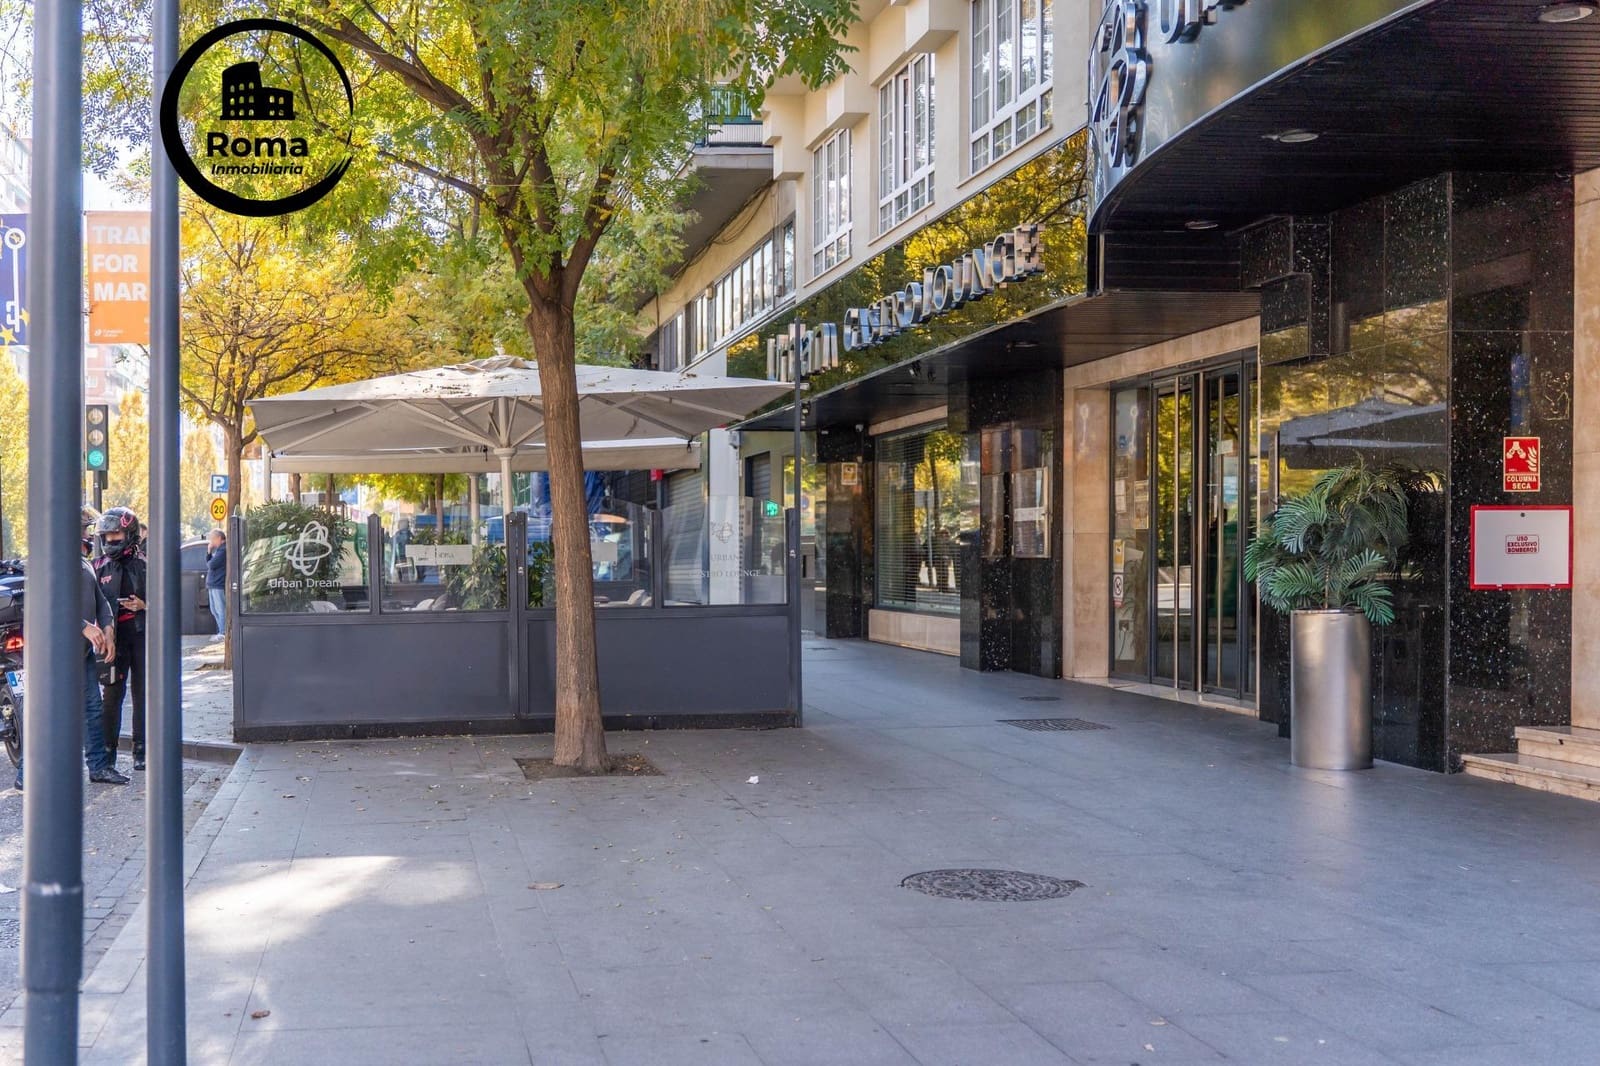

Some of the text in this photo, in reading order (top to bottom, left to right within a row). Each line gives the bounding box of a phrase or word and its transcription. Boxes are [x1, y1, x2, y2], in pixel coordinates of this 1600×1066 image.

[92, 254, 138, 273] FOR
[94, 282, 148, 302] MAR
[212, 476, 225, 492] P
[1511, 482, 1531, 490] SECA
[213, 504, 225, 514] 20
[268, 577, 302, 588] Urban
